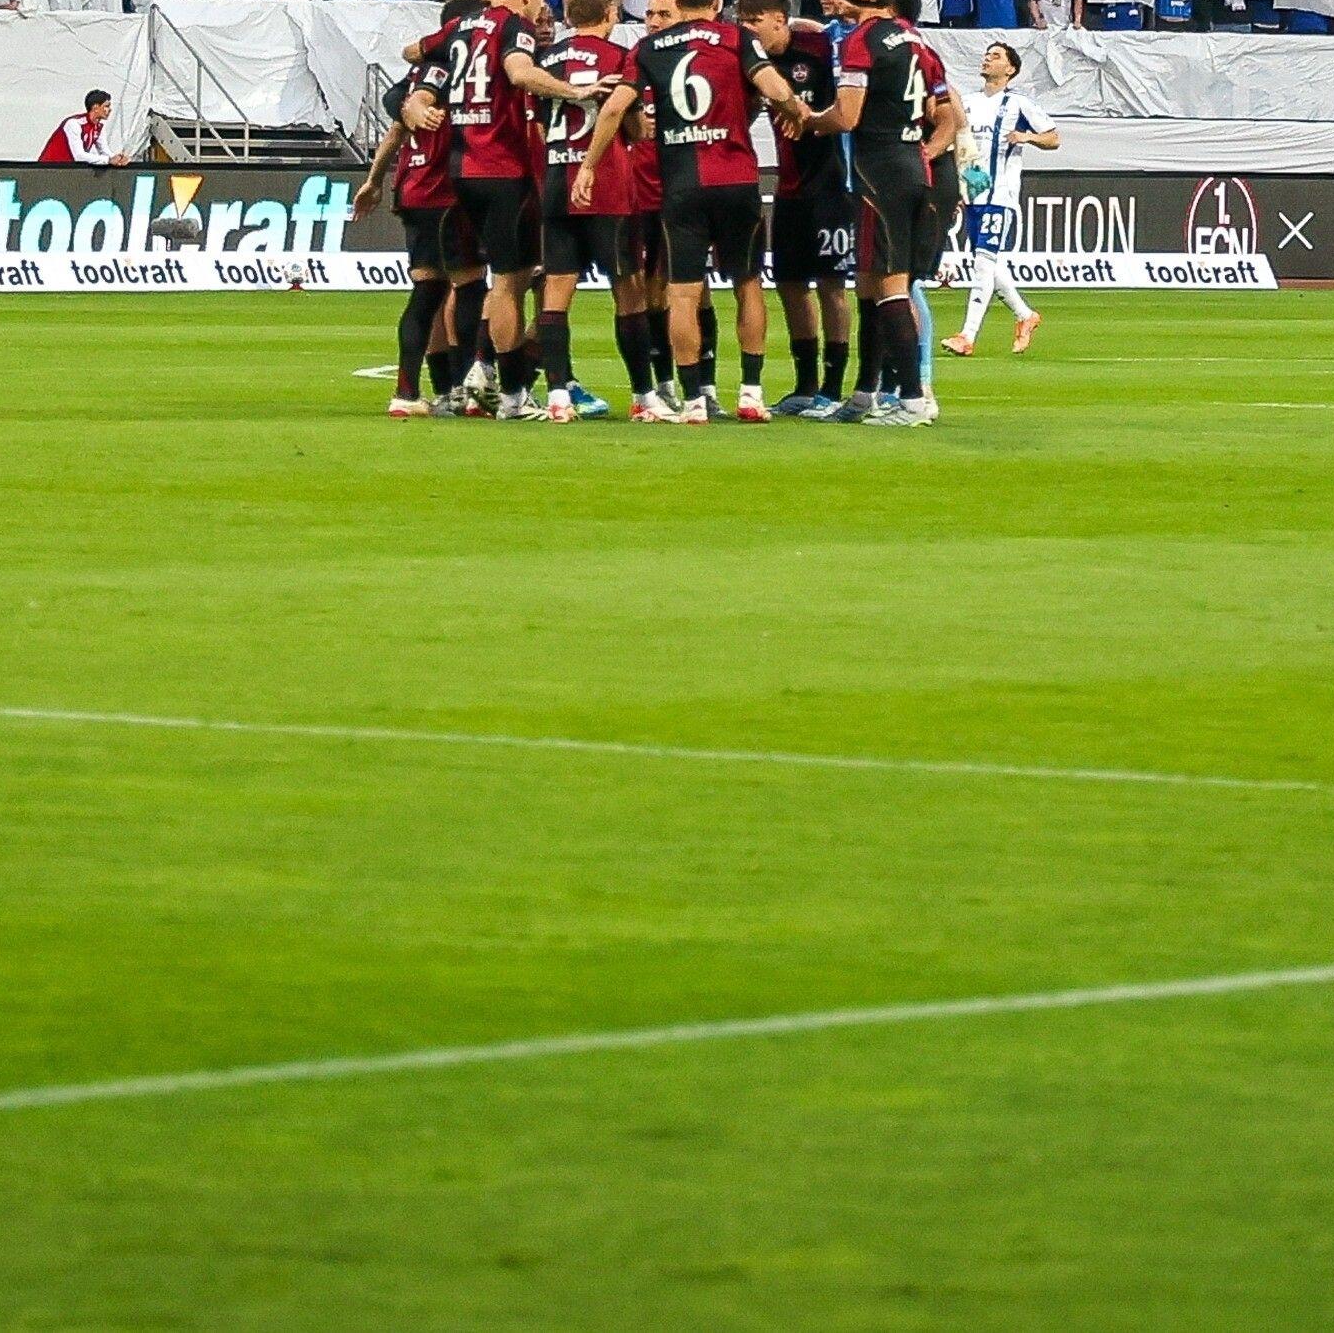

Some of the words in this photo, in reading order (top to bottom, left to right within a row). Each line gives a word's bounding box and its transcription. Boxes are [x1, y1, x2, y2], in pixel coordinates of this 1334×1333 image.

[653, 27, 721, 50] Nürnberg
[449, 39, 492, 103] 24
[670, 50, 713, 122] 6
[903, 53, 927, 121] 4
[548, 147, 589, 164] Becke
[979, 212, 1003, 234] 23
[817, 228, 849, 256] 20
[71, 258, 188, 285] toolcraft
[215, 258, 330, 283] toolcft
[1007, 258, 1117, 283] toolcraft
[1145, 259, 1259, 283] toolcraft
